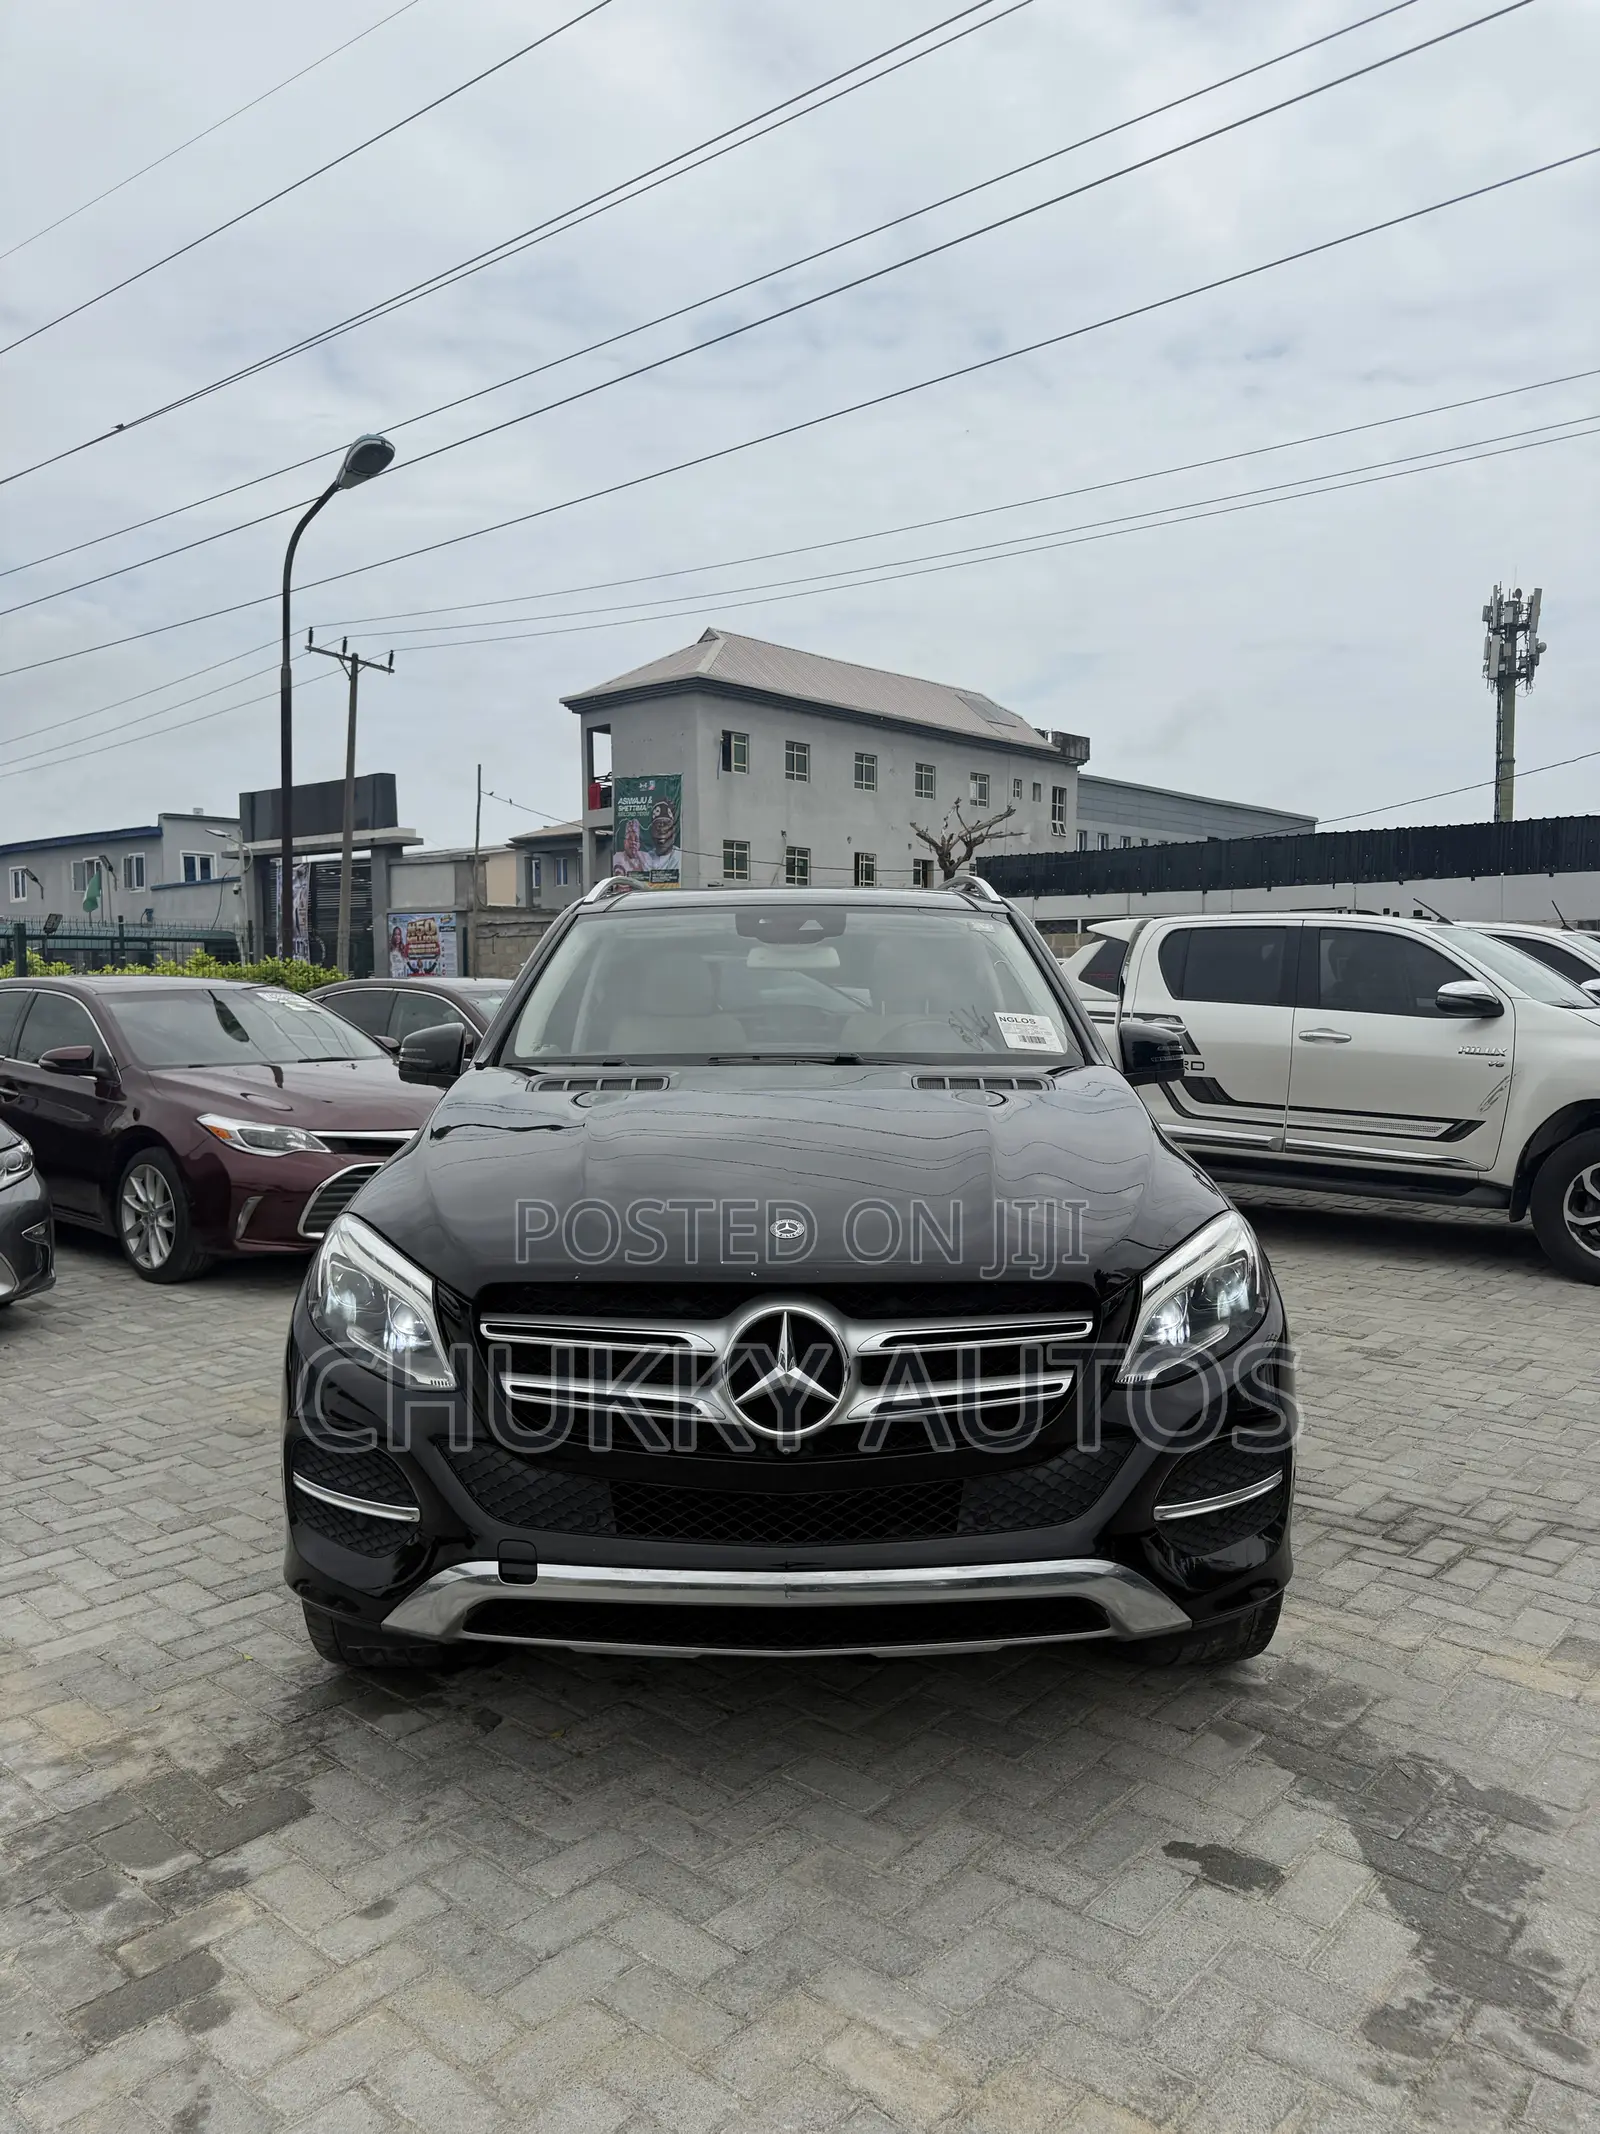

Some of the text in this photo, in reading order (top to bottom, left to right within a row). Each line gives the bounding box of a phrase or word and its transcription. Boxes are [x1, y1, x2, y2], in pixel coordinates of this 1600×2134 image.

[998, 1016, 1037, 1025] NGLOS
[1457, 1045, 1508, 1057] HILUX
[1183, 1060, 1205, 1071] RD
